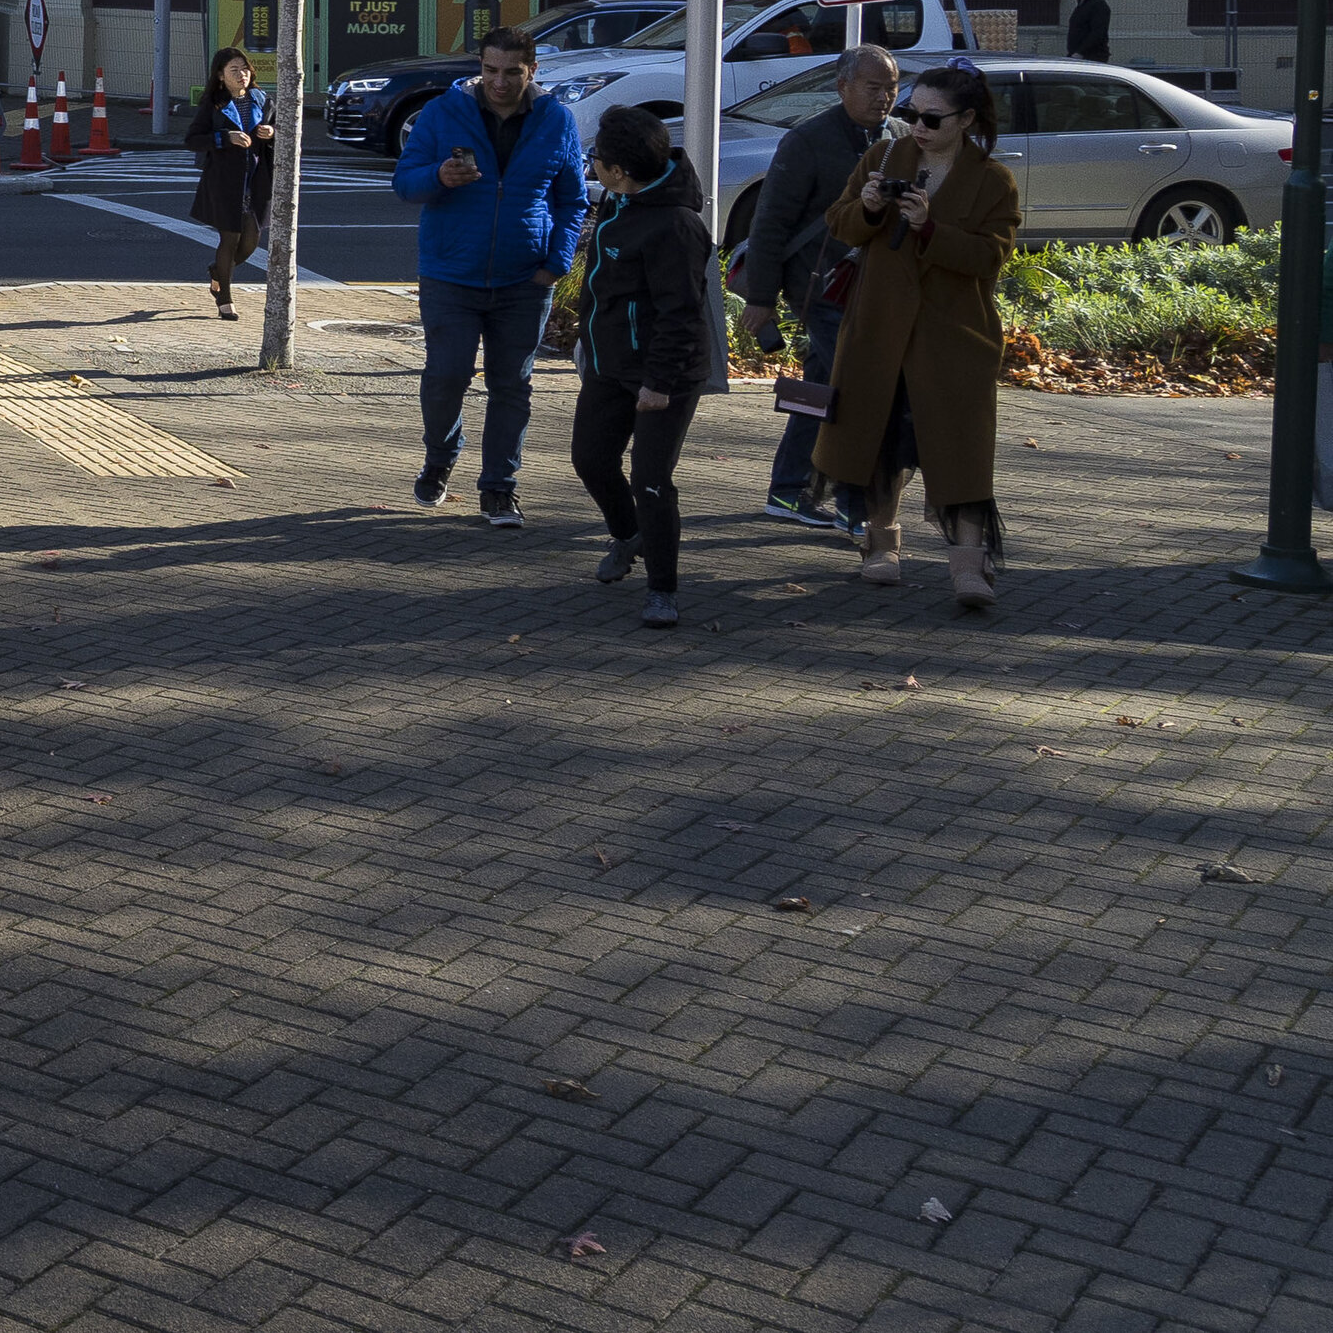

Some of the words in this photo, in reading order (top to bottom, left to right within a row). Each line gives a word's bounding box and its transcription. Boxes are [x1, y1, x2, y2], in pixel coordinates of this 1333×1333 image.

[349, 0, 360, 12] IT
[363, 0, 398, 12] JUST
[252, 5, 260, 37] MAJOR
[260, 5, 269, 37] MAJOR
[346, 23, 400, 34] MAJOR
[358, 12, 389, 24] GOT
[472, 8, 481, 40] MAJOR
